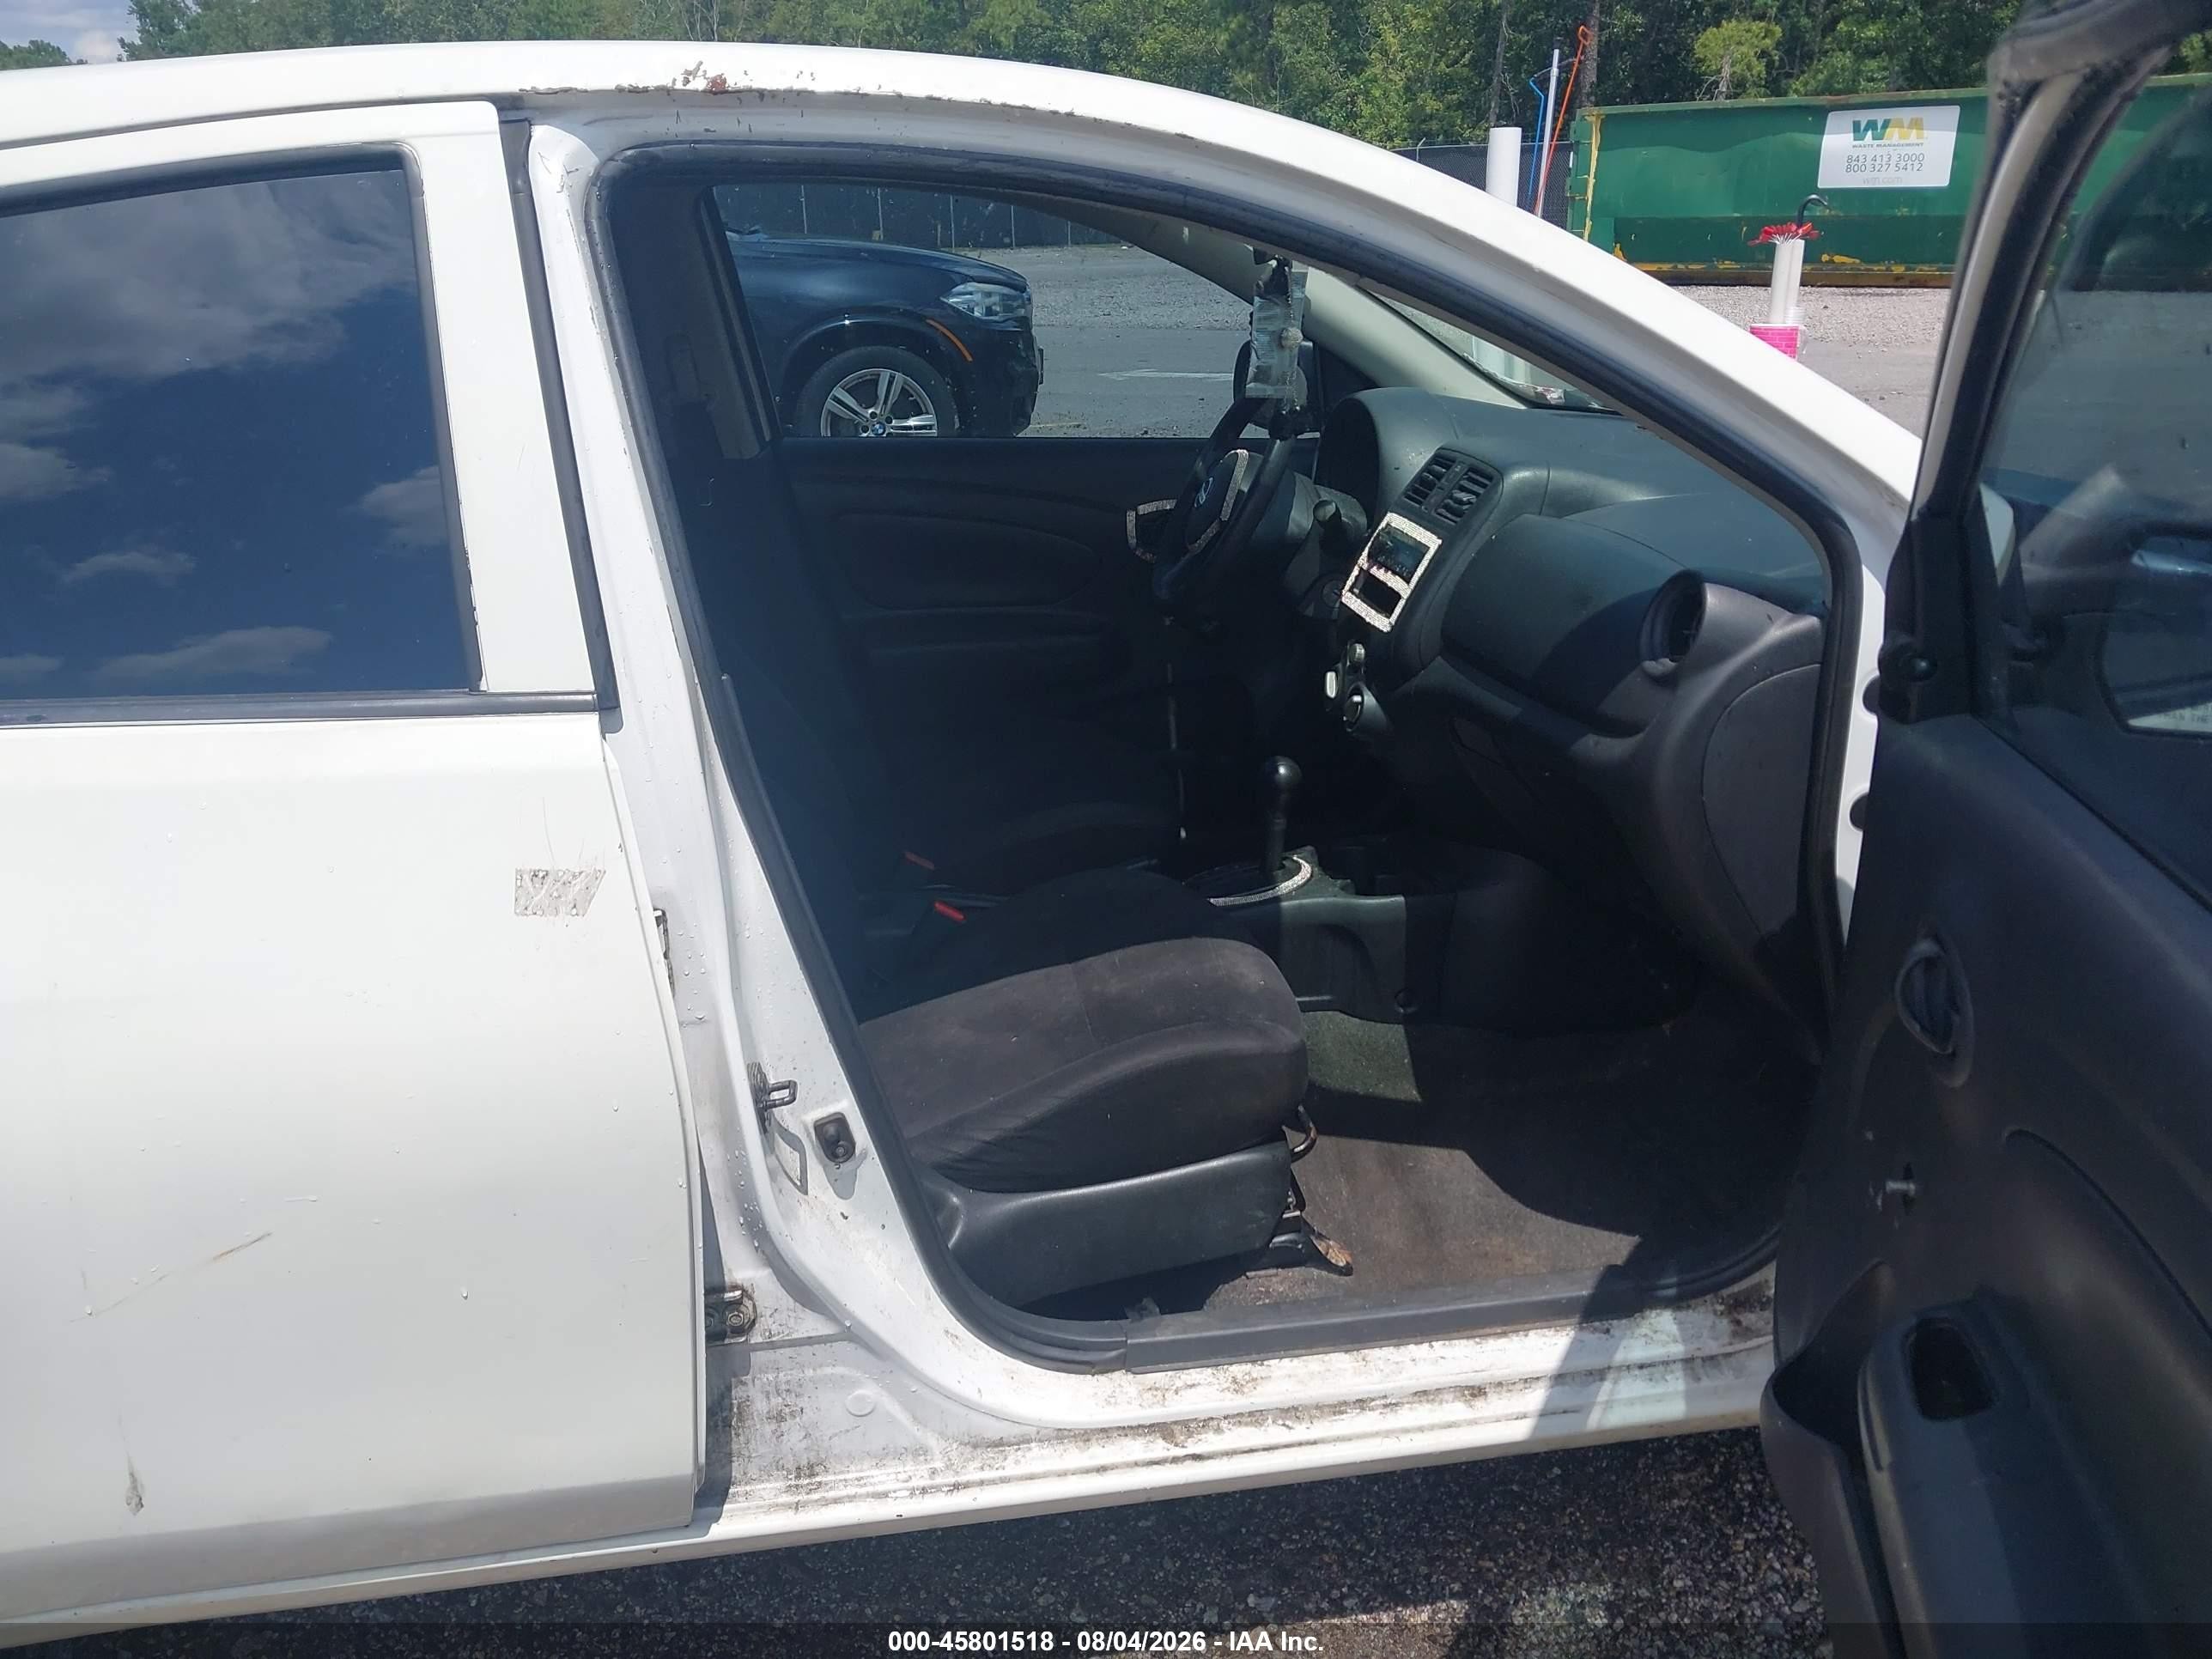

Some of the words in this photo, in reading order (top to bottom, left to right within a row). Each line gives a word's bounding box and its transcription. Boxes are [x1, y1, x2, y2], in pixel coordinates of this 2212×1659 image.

[1852, 117, 1924, 142] WM
[1846, 154, 1867, 163] 843
[1870, 153, 1892, 163] 413
[1896, 153, 1925, 162] 3000
[1845, 163, 1867, 173] 800
[1868, 163, 1891, 173] 327
[1894, 162, 1923, 173] 5412
